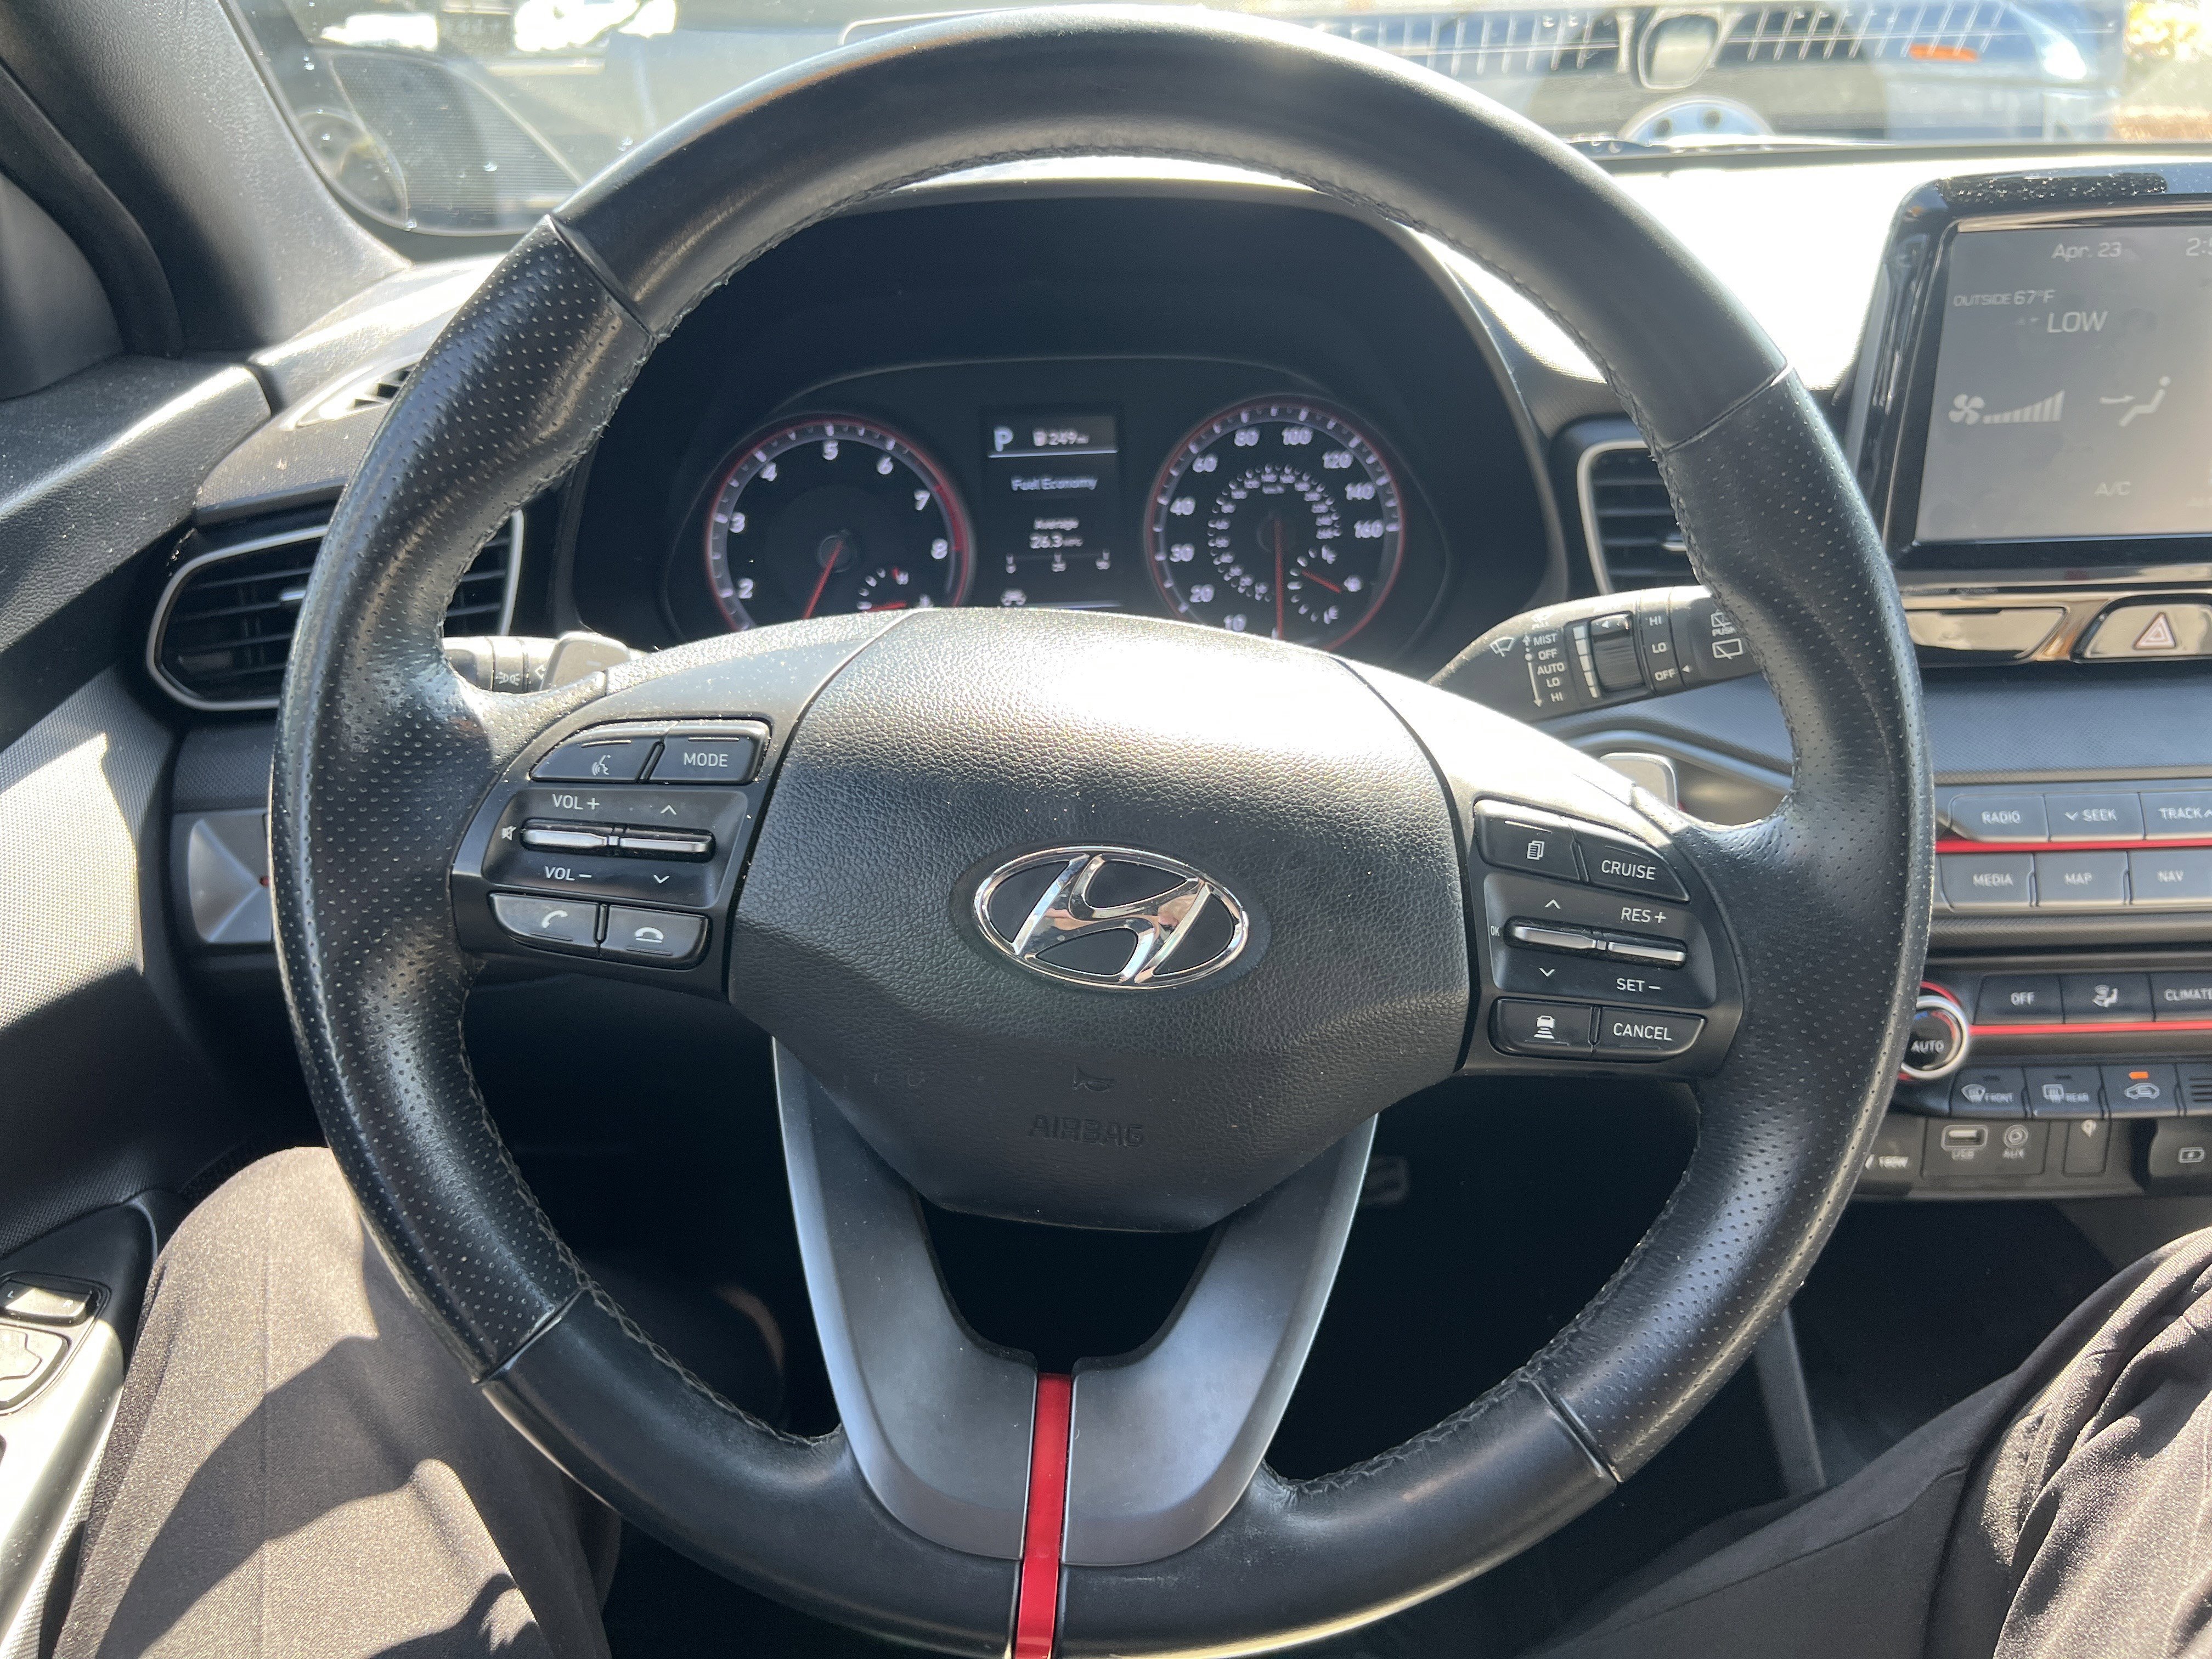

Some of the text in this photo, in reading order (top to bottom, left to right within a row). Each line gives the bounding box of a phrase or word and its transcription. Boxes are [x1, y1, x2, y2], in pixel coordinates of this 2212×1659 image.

[2051, 242, 2122, 262] Apr. 23
[1954, 293, 2012, 307] OUTSIDE
[2047, 310, 2109, 333] LOW
[994, 427, 1013, 452] P
[822, 440, 838, 460] 5
[760, 462, 777, 481] 4
[878, 456, 893, 475] 6
[2095, 481, 2131, 497] A/C
[914, 490, 929, 510] 7
[730, 512, 745, 533] 3
[931, 538, 947, 559] 8
[738, 578, 753, 599] 2
[1649, 616, 1662, 627] HI
[1533, 633, 1558, 646] MIST
[1538, 647, 1558, 661] OFF
[1651, 641, 1667, 654] LO
[1537, 662, 1565, 676] AUTO
[1654, 668, 1675, 682] OFF
[1546, 676, 1561, 688] LO
[1550, 692, 1564, 703] HI
[684, 752, 729, 767] MODE
[1982, 810, 2021, 824] RADIO
[2082, 808, 2117, 822] SEEK
[2158, 807, 2201, 821] TRACK
[1601, 859, 1656, 881] CRUISE
[2157, 870, 2183, 882] NAV
[1973, 873, 2013, 887] MEDIA
[2064, 872, 2092, 885] MAP
[1490, 926, 1500, 936] OK
[2011, 992, 2034, 1005] OFF
[1613, 1022, 1672, 1042] CANCEL
[1911, 1040, 1944, 1052] AUTO
[1026, 1115, 1143, 1147] AIRBAG
